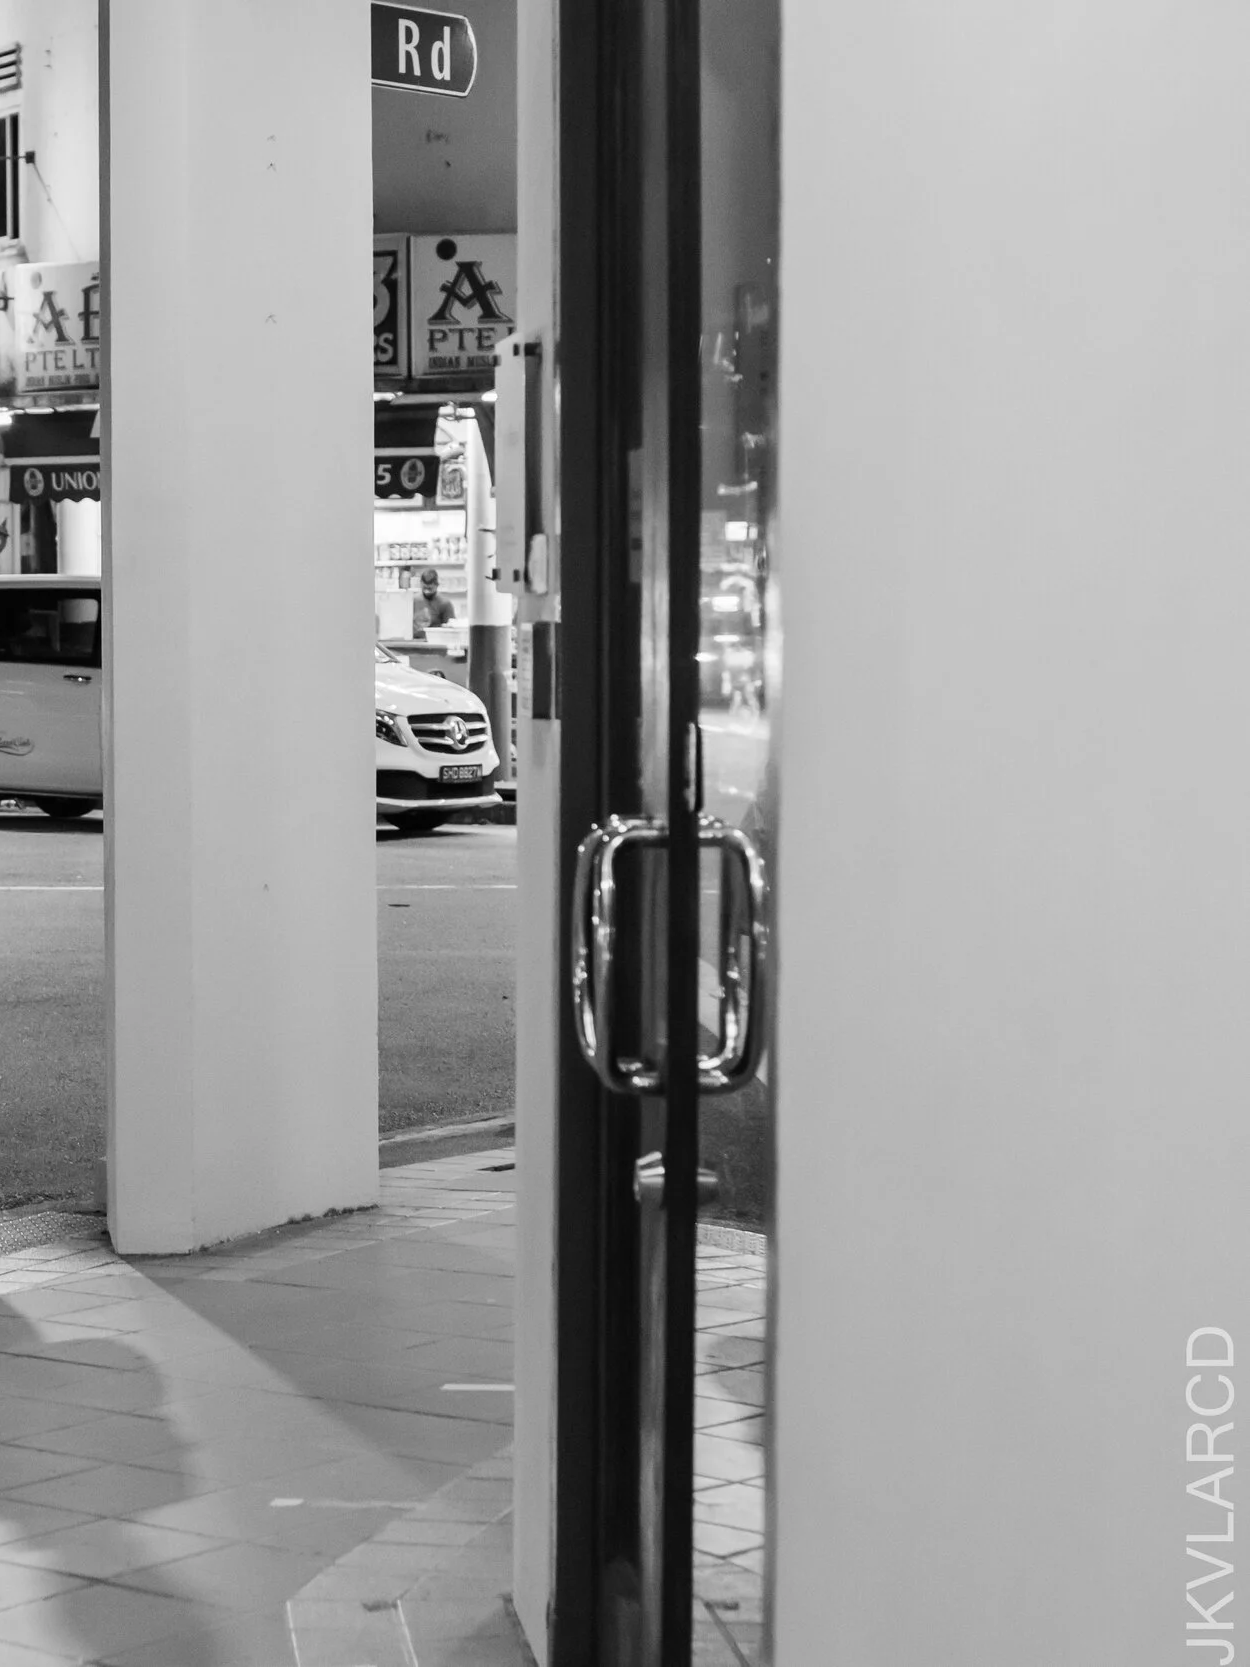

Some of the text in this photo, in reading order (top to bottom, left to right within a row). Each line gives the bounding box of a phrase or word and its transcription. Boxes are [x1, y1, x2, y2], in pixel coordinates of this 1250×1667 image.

[398, 18, 452, 81] Rd
[427, 261, 515, 326] A
[427, 327, 496, 354] PTE
